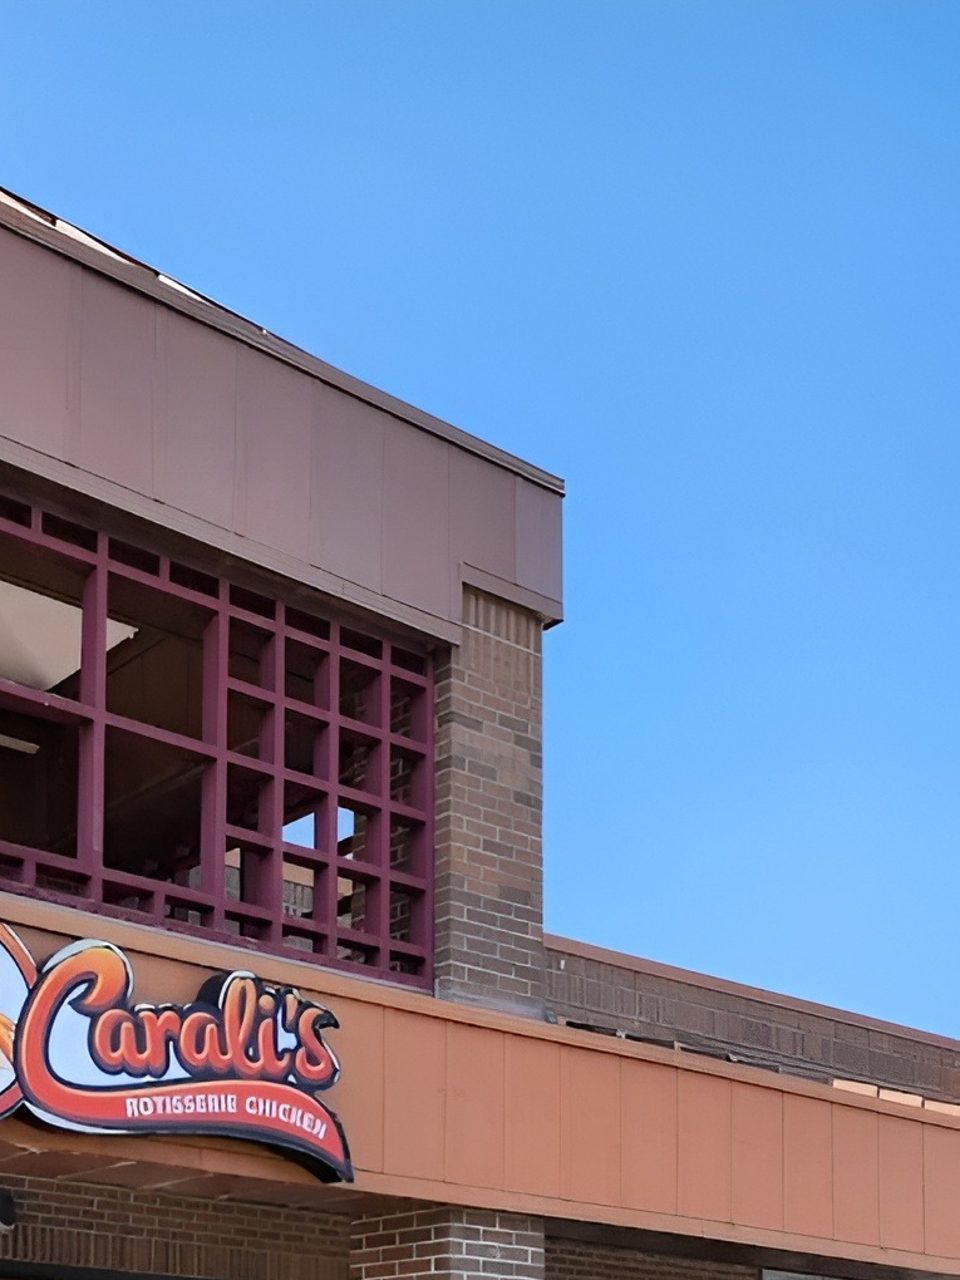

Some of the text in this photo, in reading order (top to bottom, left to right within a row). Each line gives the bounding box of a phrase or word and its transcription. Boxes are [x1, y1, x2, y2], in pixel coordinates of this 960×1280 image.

[18, 943, 338, 1096] Carali's
[126, 1094, 327, 1140] ROTISSERIE CHICKEN
